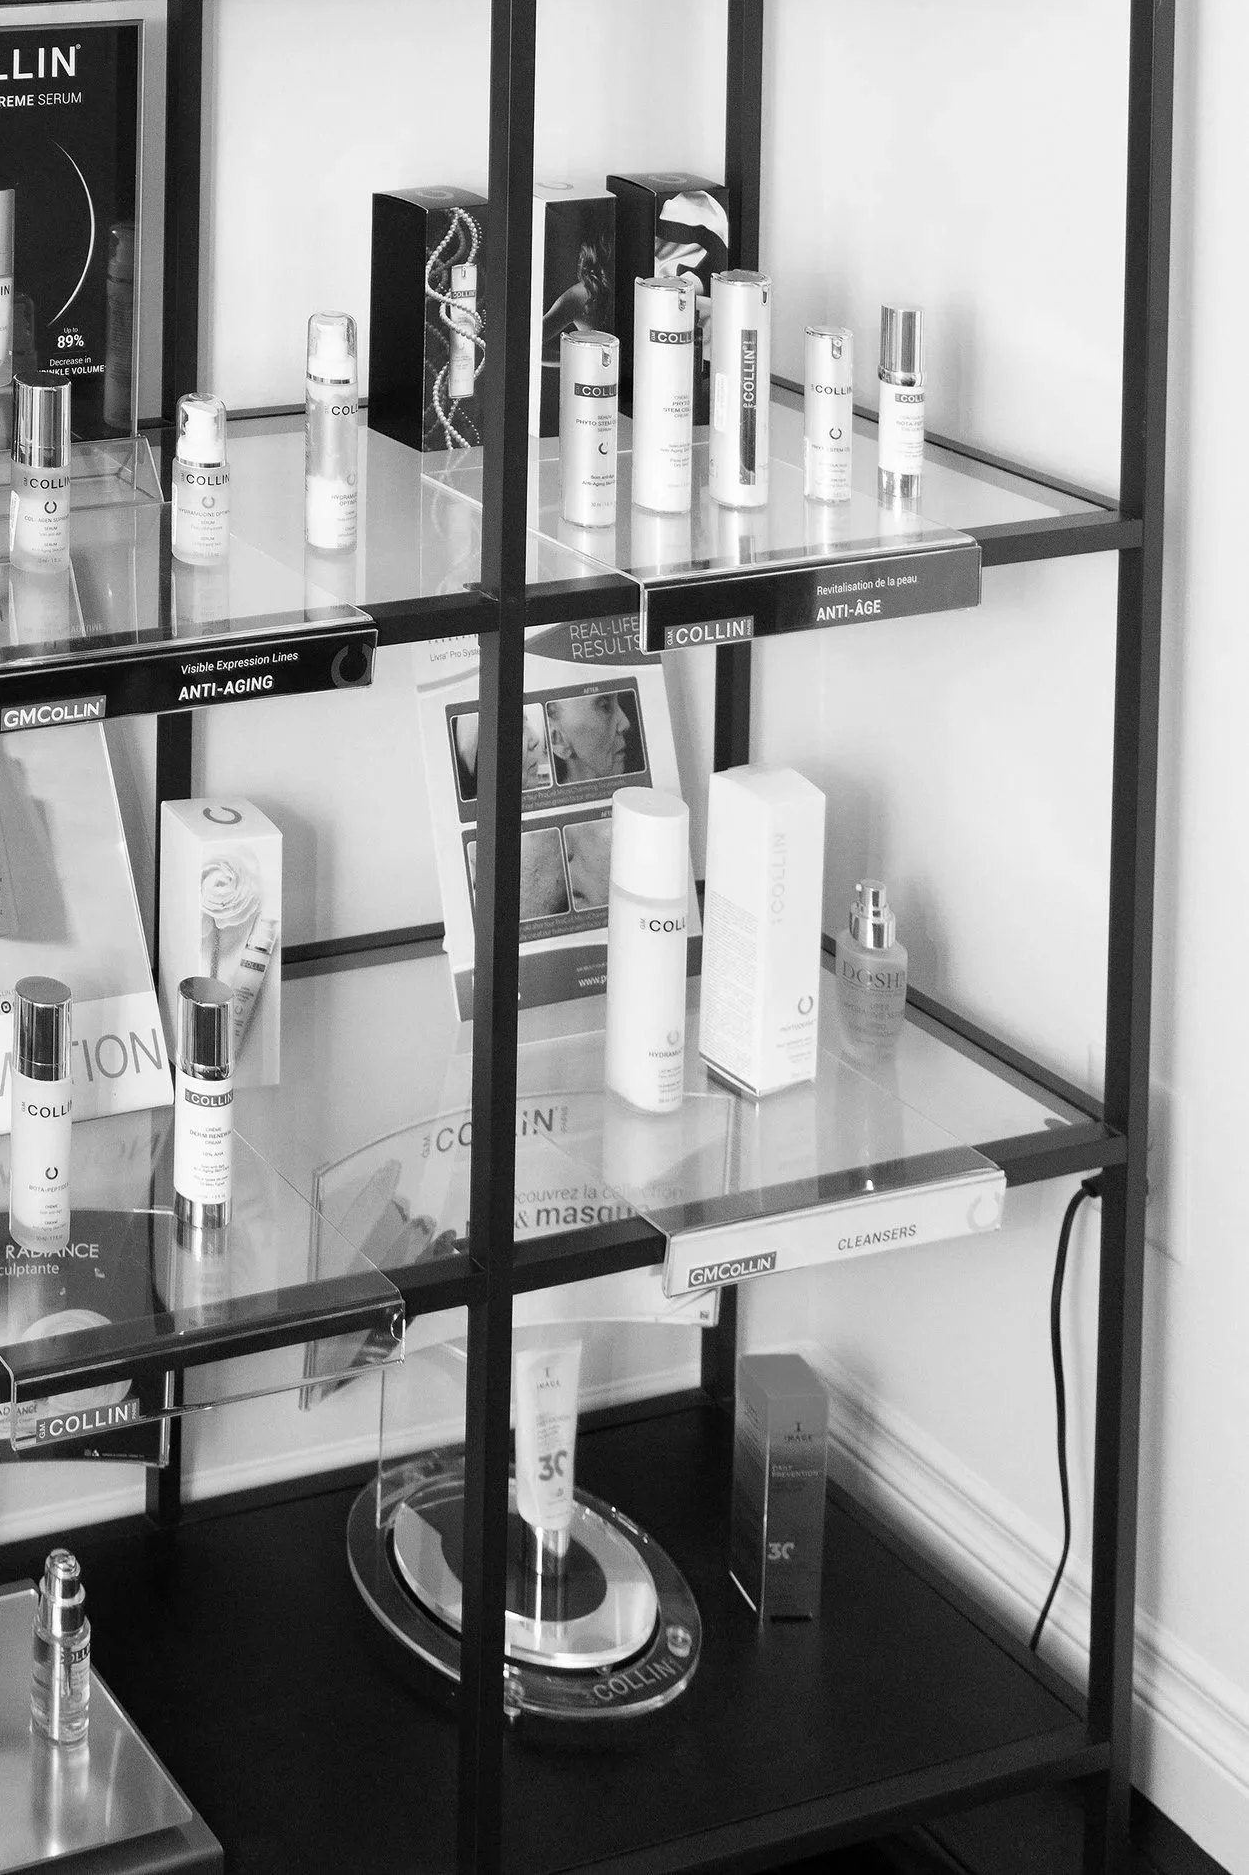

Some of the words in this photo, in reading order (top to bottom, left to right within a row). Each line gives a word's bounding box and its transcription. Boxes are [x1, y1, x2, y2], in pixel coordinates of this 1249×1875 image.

[38, 92, 82, 106] SERUM
[57, 334, 84, 349] 89%
[50, 358, 80, 367] Decrease
[71, 365, 104, 375] VOLUME
[744, 348, 756, 402] COLLIN
[817, 578, 872, 596] Revitalisation
[875, 578, 885, 589] de
[888, 577, 895, 587] la
[897, 575, 917, 589] peau
[570, 616, 639, 640] REAL-LIFE
[676, 621, 745, 644] COLLIN
[817, 600, 881, 621] ANTI-ÂGE
[571, 635, 642, 658] RESULTS
[181, 660, 213, 674] Visible
[216, 654, 270, 672] Expression
[272, 651, 299, 665] Lines
[179, 675, 273, 701] ANTI-AGING
[584, 686, 599, 694] AFTER
[838, 1224, 917, 1251] CLEANSERS
[50, 1405, 128, 1436] COLLIN
[593, 1660, 675, 1703] COLLIN
